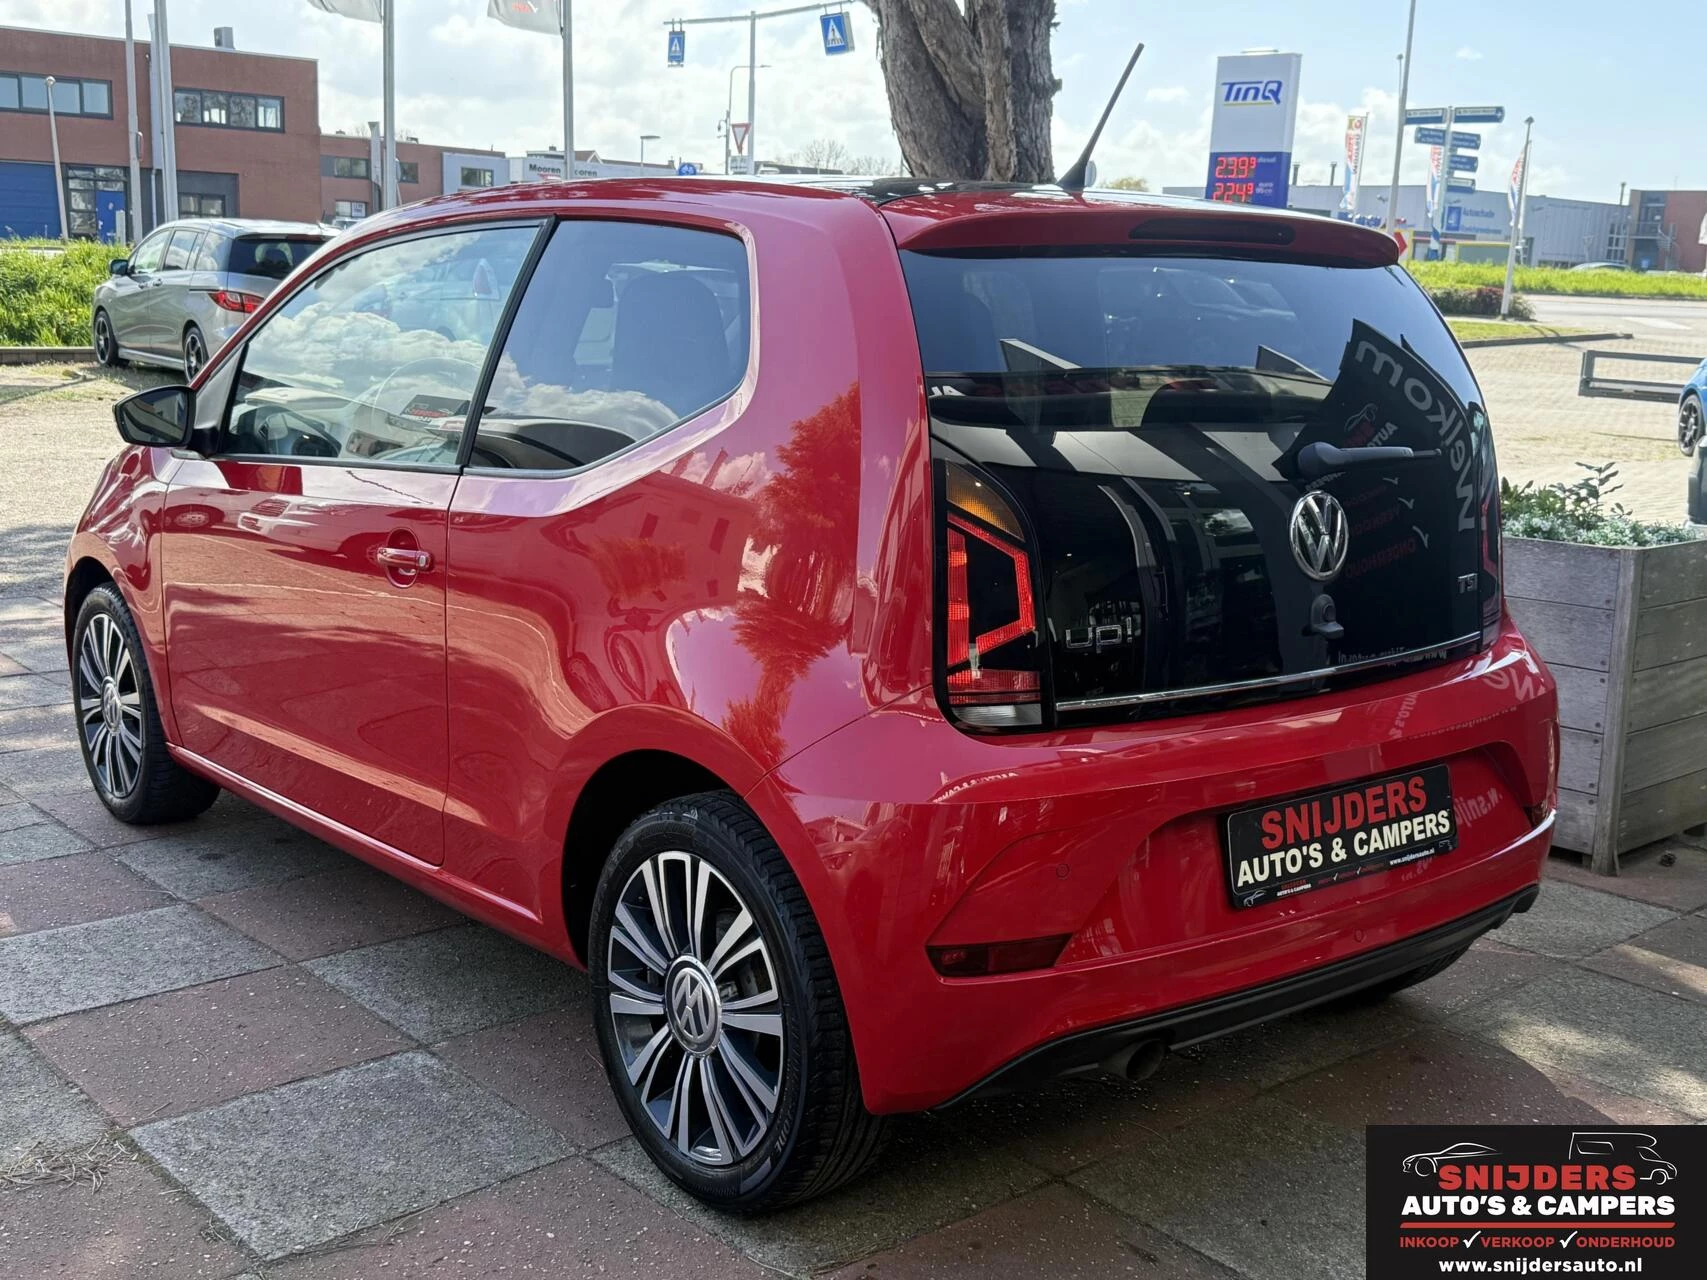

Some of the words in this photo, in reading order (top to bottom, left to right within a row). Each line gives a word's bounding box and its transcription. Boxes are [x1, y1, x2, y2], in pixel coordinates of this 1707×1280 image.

[1222, 80, 1282, 105] TinQ
[529, 163, 561, 174] Mooren
[1065, 616, 1132, 654] up!
[1261, 776, 1427, 850] SNIJDERS
[1237, 842, 1323, 888] AUTO'S
[1330, 836, 1348, 864] &
[1353, 808, 1451, 857] CAMPERS
